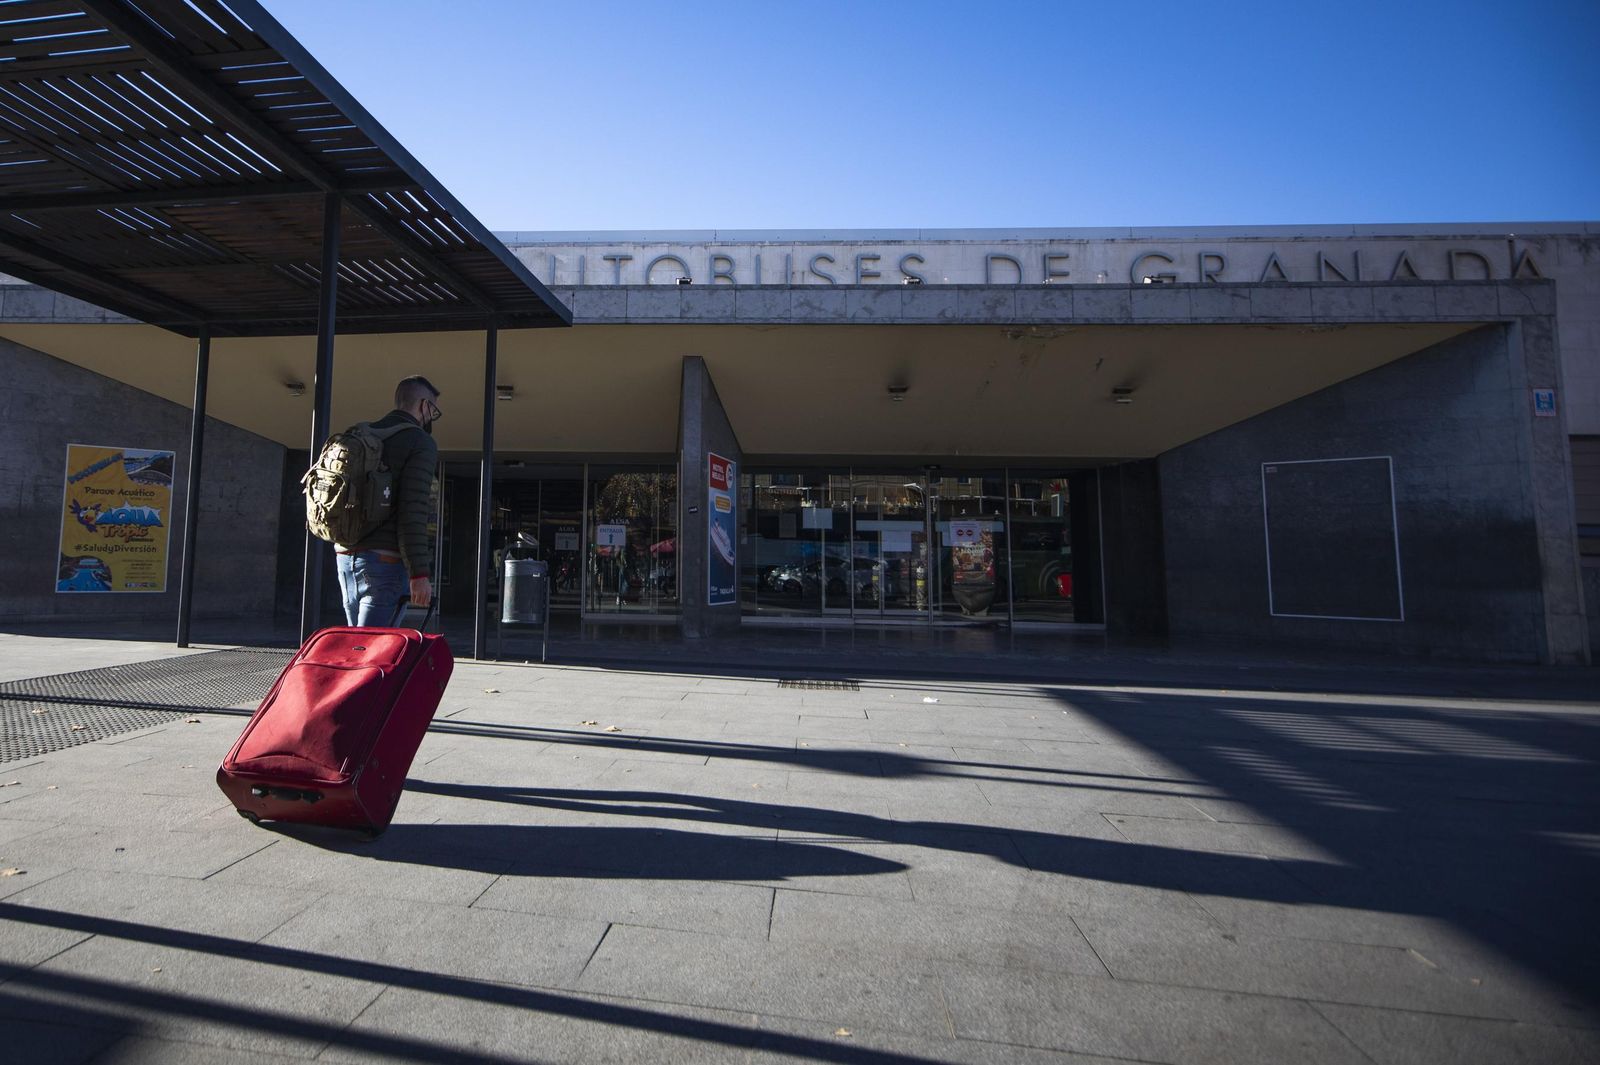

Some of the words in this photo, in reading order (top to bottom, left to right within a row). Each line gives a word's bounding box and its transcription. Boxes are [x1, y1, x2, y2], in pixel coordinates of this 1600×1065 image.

[550, 253, 928, 285] UTOBUSES
[985, 252, 1070, 284] DE
[1130, 248, 1544, 284] GRANADA
[84, 486, 115, 496] Parque
[118, 487, 155, 497] Acuático
[95, 508, 164, 527] AQUA
[102, 526, 149, 543] Tropic
